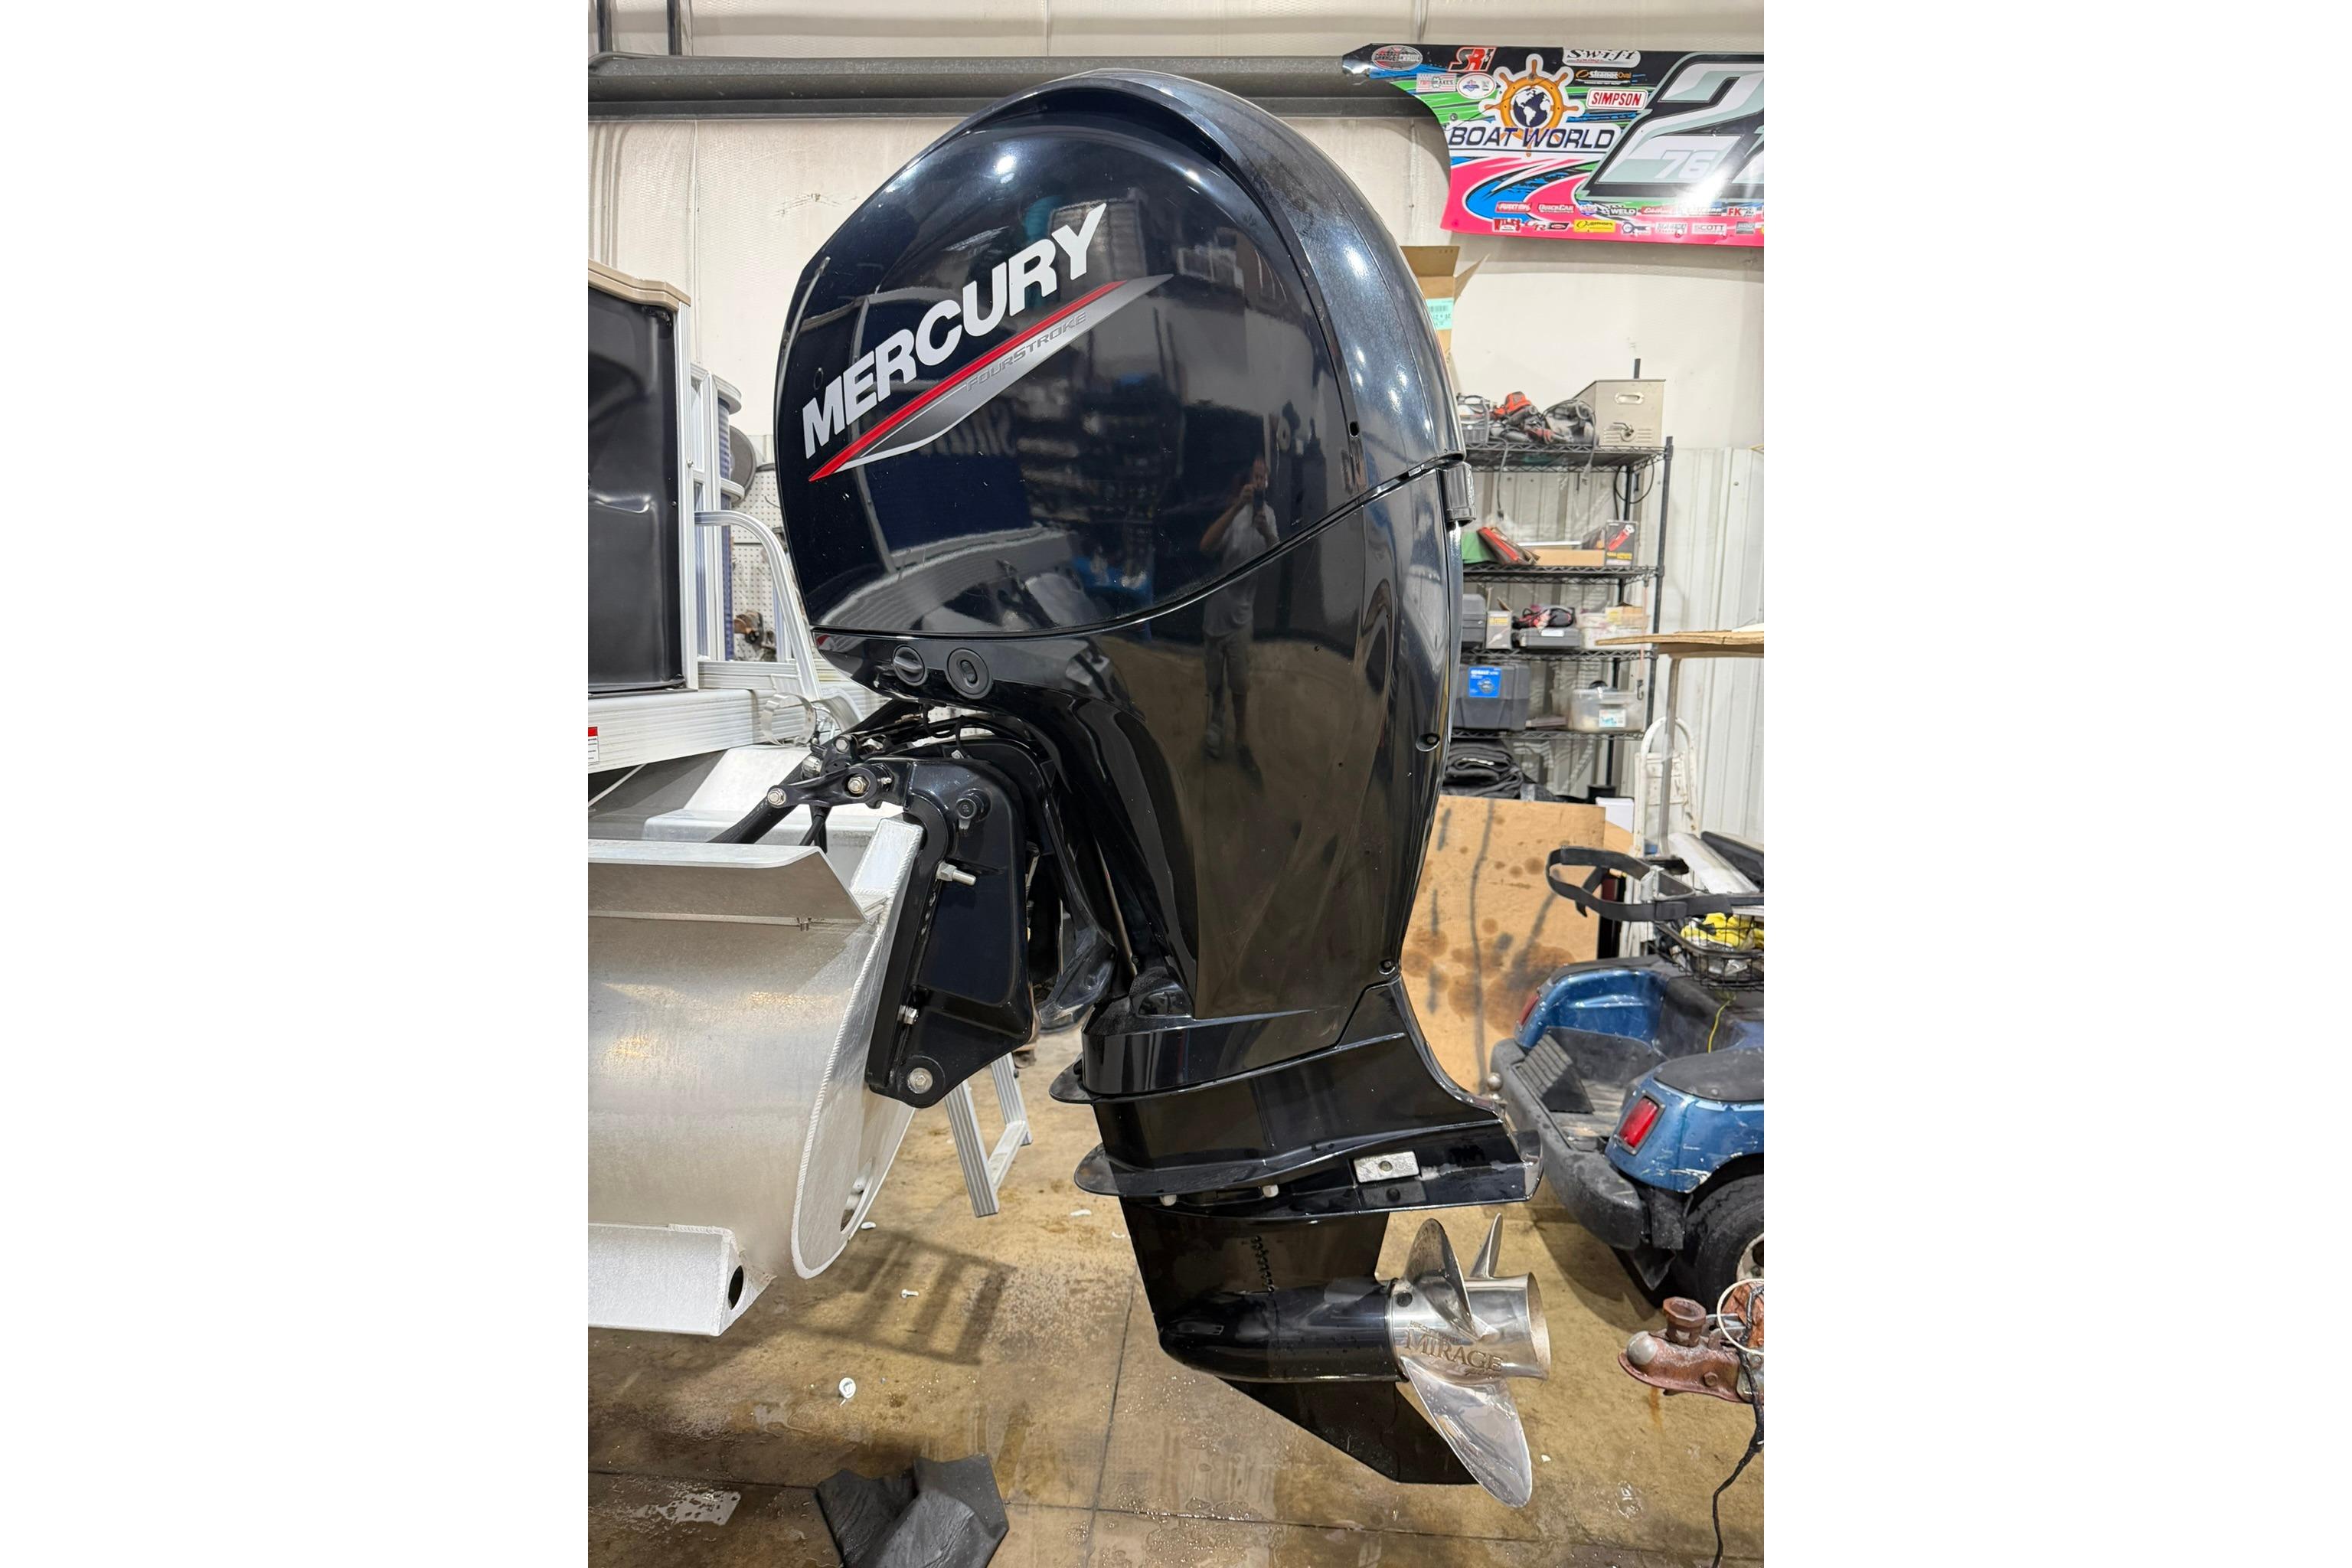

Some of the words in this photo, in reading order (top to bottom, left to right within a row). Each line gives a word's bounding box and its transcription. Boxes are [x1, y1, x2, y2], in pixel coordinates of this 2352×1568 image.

[1591, 92, 1642, 106] SIMPSON
[1449, 126, 1518, 147] BOAT
[1522, 129, 1615, 149] WORLD
[1654, 149, 1720, 179] 76
[802, 203, 1107, 459] MERCURY
[965, 312, 1086, 392] FOURSTROKE
[1403, 1328, 1504, 1372] MIRAGE
